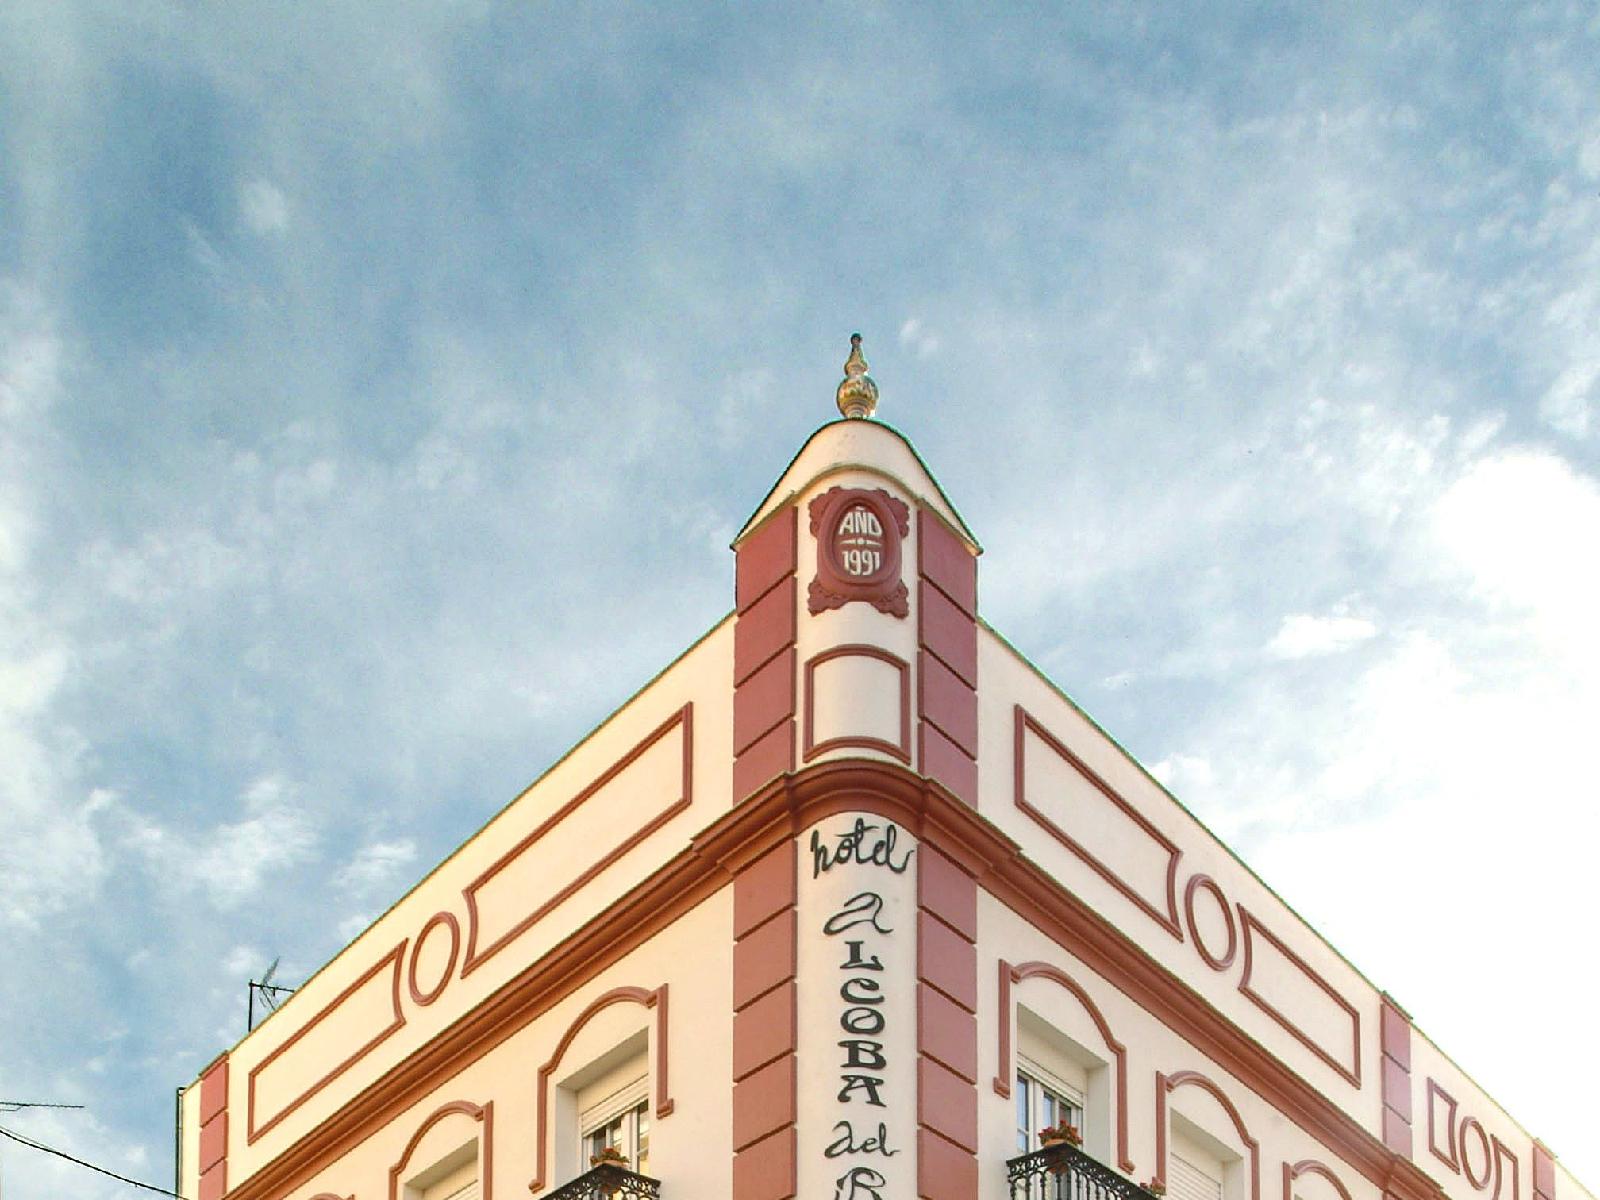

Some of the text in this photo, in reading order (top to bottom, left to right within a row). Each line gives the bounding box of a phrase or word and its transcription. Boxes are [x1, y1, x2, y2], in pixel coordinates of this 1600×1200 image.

[842, 550, 880, 576] 1991
[810, 817, 914, 879] hotel
[825, 1120, 900, 1158] del
